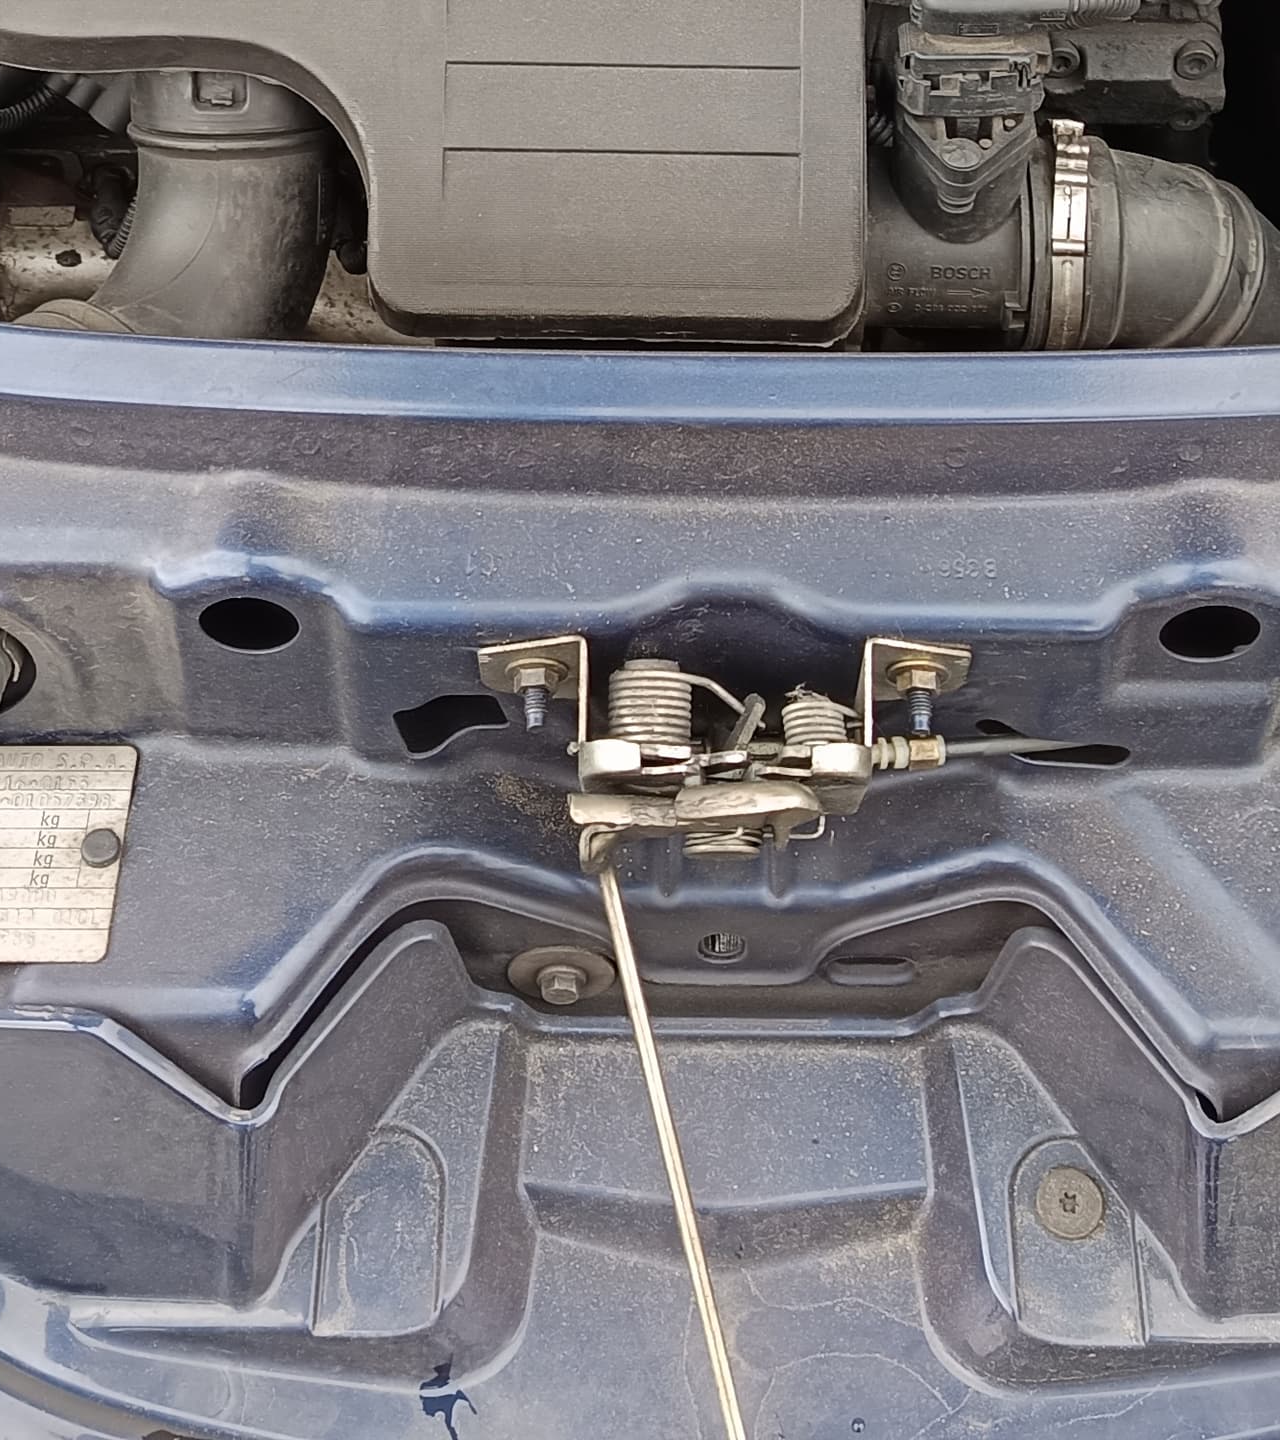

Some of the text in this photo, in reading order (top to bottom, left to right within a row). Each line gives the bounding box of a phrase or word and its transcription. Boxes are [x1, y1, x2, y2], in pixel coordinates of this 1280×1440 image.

[930, 264, 992, 281] BOSCH
[56, 752, 127, 770] S.P.A.
[41, 811, 61, 828] kg
[37, 831, 57, 849] kg
[33, 850, 53, 868] kg
[29, 870, 49, 888] kg
